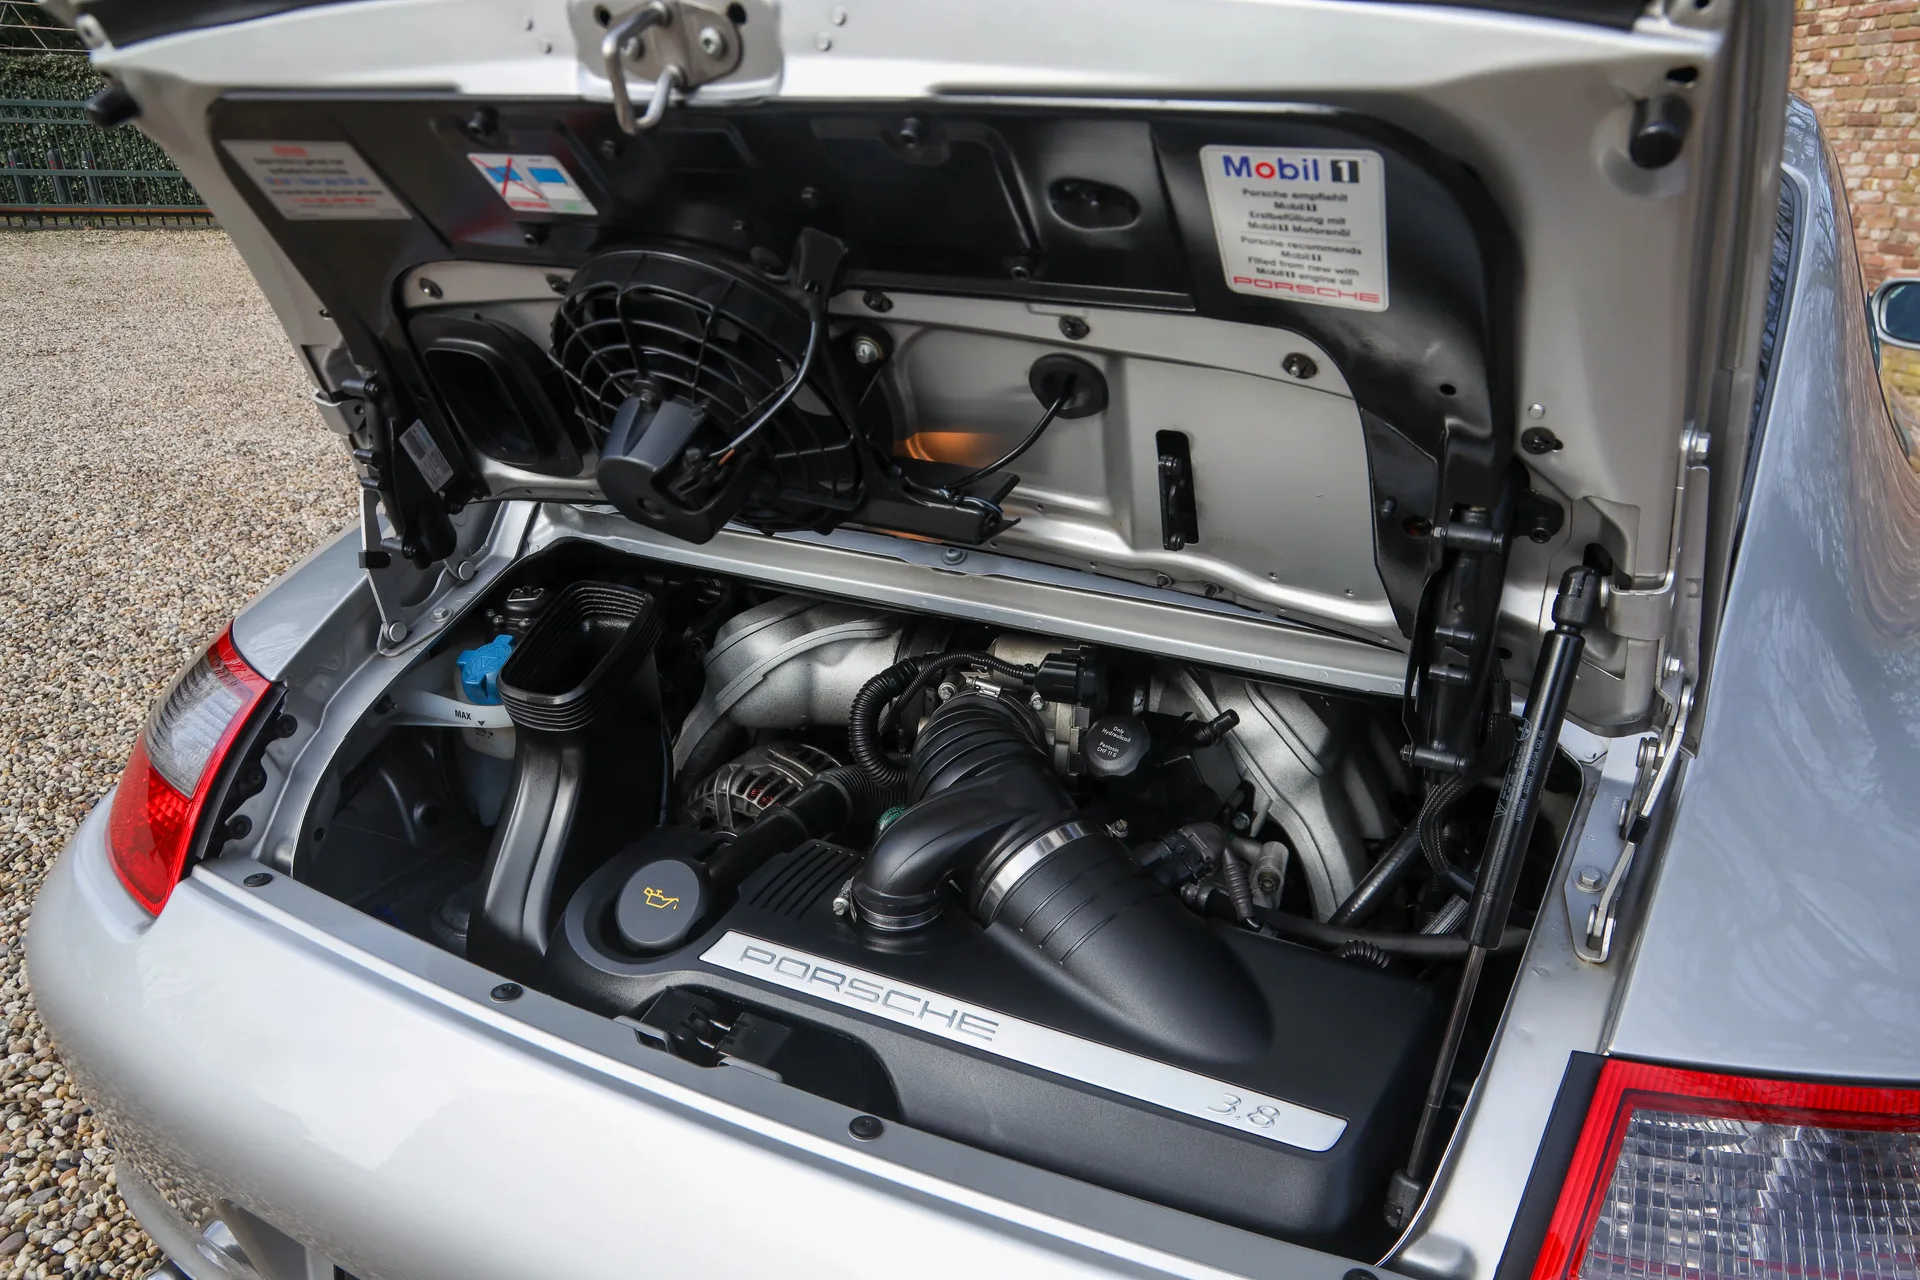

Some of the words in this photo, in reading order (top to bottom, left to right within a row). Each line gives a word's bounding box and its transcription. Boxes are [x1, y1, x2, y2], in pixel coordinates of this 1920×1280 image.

[1222, 154, 1320, 181] Mobil
[1332, 160, 1355, 183] 1
[1242, 188, 1289, 199] Porsche
[1274, 201, 1304, 211] Mobil
[1248, 220, 1277, 231] Mobil
[1327, 217, 1346, 225] mit
[1240, 235, 1284, 248] Porsche
[1287, 241, 1363, 255] recommends
[1281, 250, 1310, 260] Mobil
[1248, 256, 1277, 267] Filled
[1279, 260, 1305, 270] from
[1308, 264, 1332, 274] new
[1334, 267, 1360, 277] with
[1256, 267, 1285, 278] Mobil
[1298, 273, 1337, 285] engine
[1339, 277, 1354, 286] oil
[1233, 276, 1380, 303] PORSCHE
[454, 709, 472, 721] MAX
[1113, 726, 1125, 734] Only
[1099, 741, 1120, 753] Pentosin
[738, 945, 999, 1043] PORSCHE
[1205, 1092, 1282, 1131] 3.8
